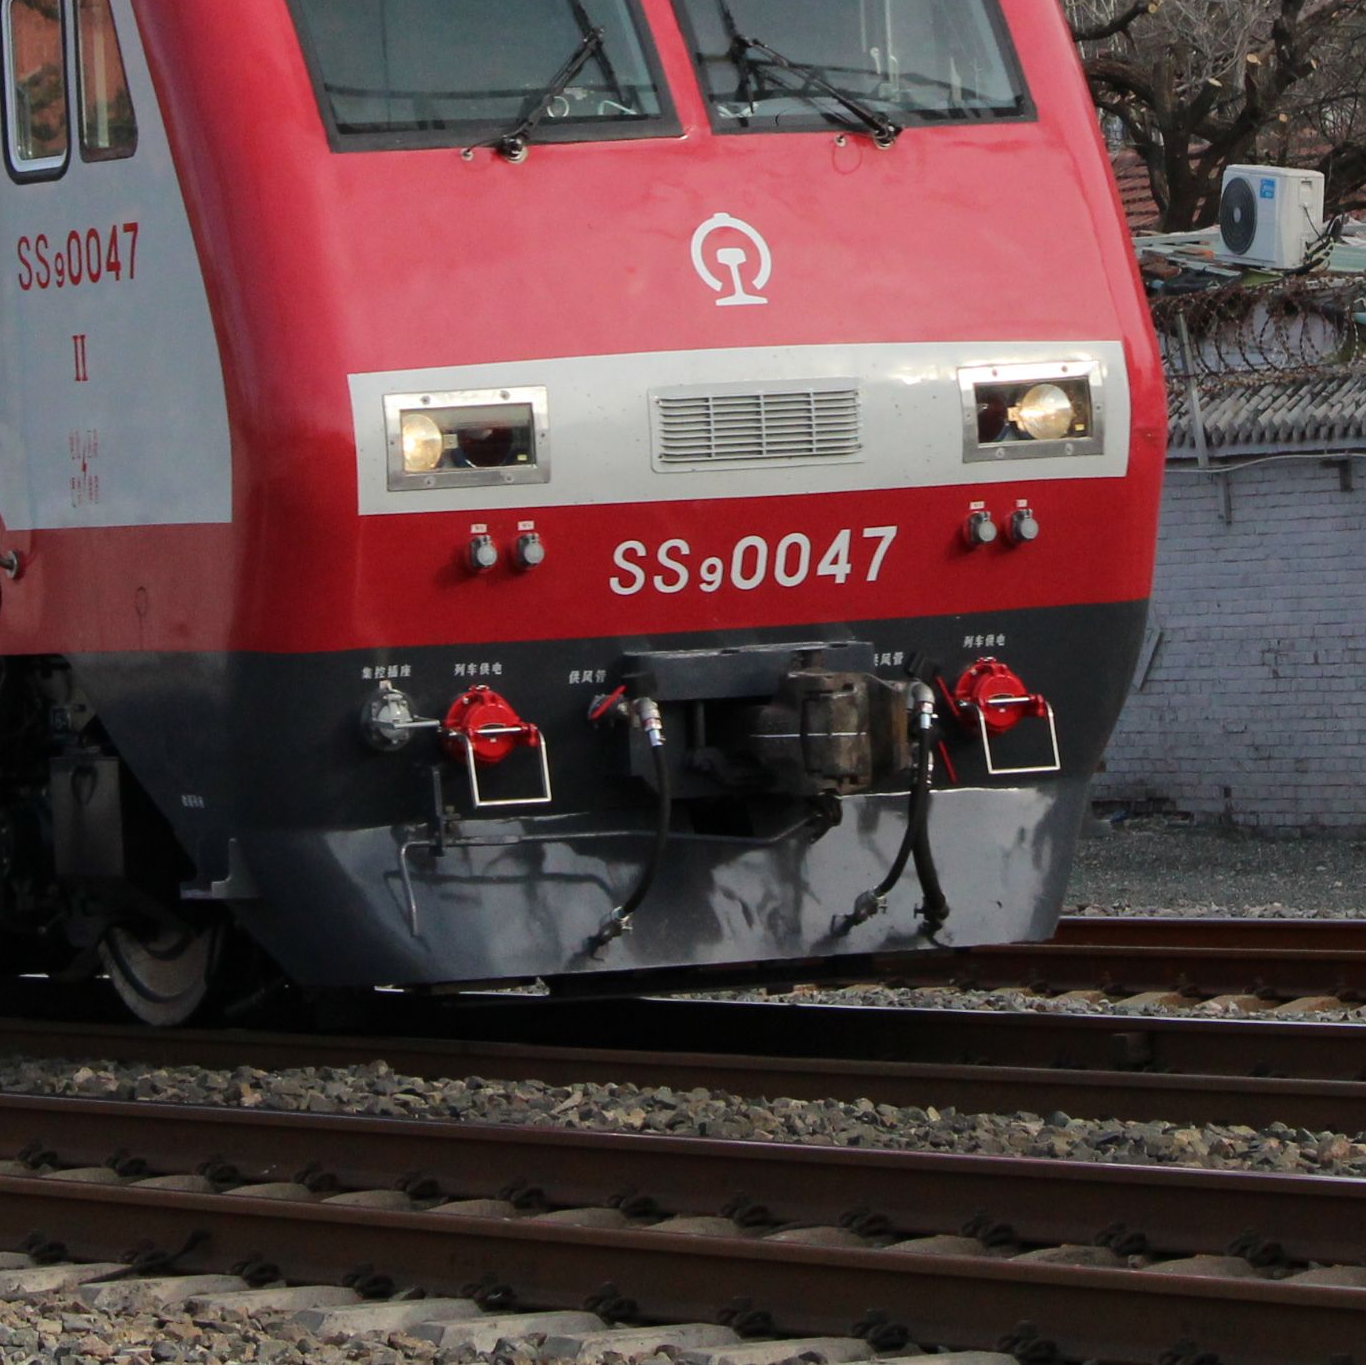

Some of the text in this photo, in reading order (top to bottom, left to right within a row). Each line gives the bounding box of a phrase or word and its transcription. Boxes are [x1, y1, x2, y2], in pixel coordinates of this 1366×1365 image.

[17, 222, 139, 290] SS90047
[609, 526, 898, 595] SS90047
[963, 633, 1006, 648] 列车供电
[362, 664, 411, 679] 集控插座
[454, 662, 502, 676] 列车供电
[569, 669, 606, 684] 供风管
